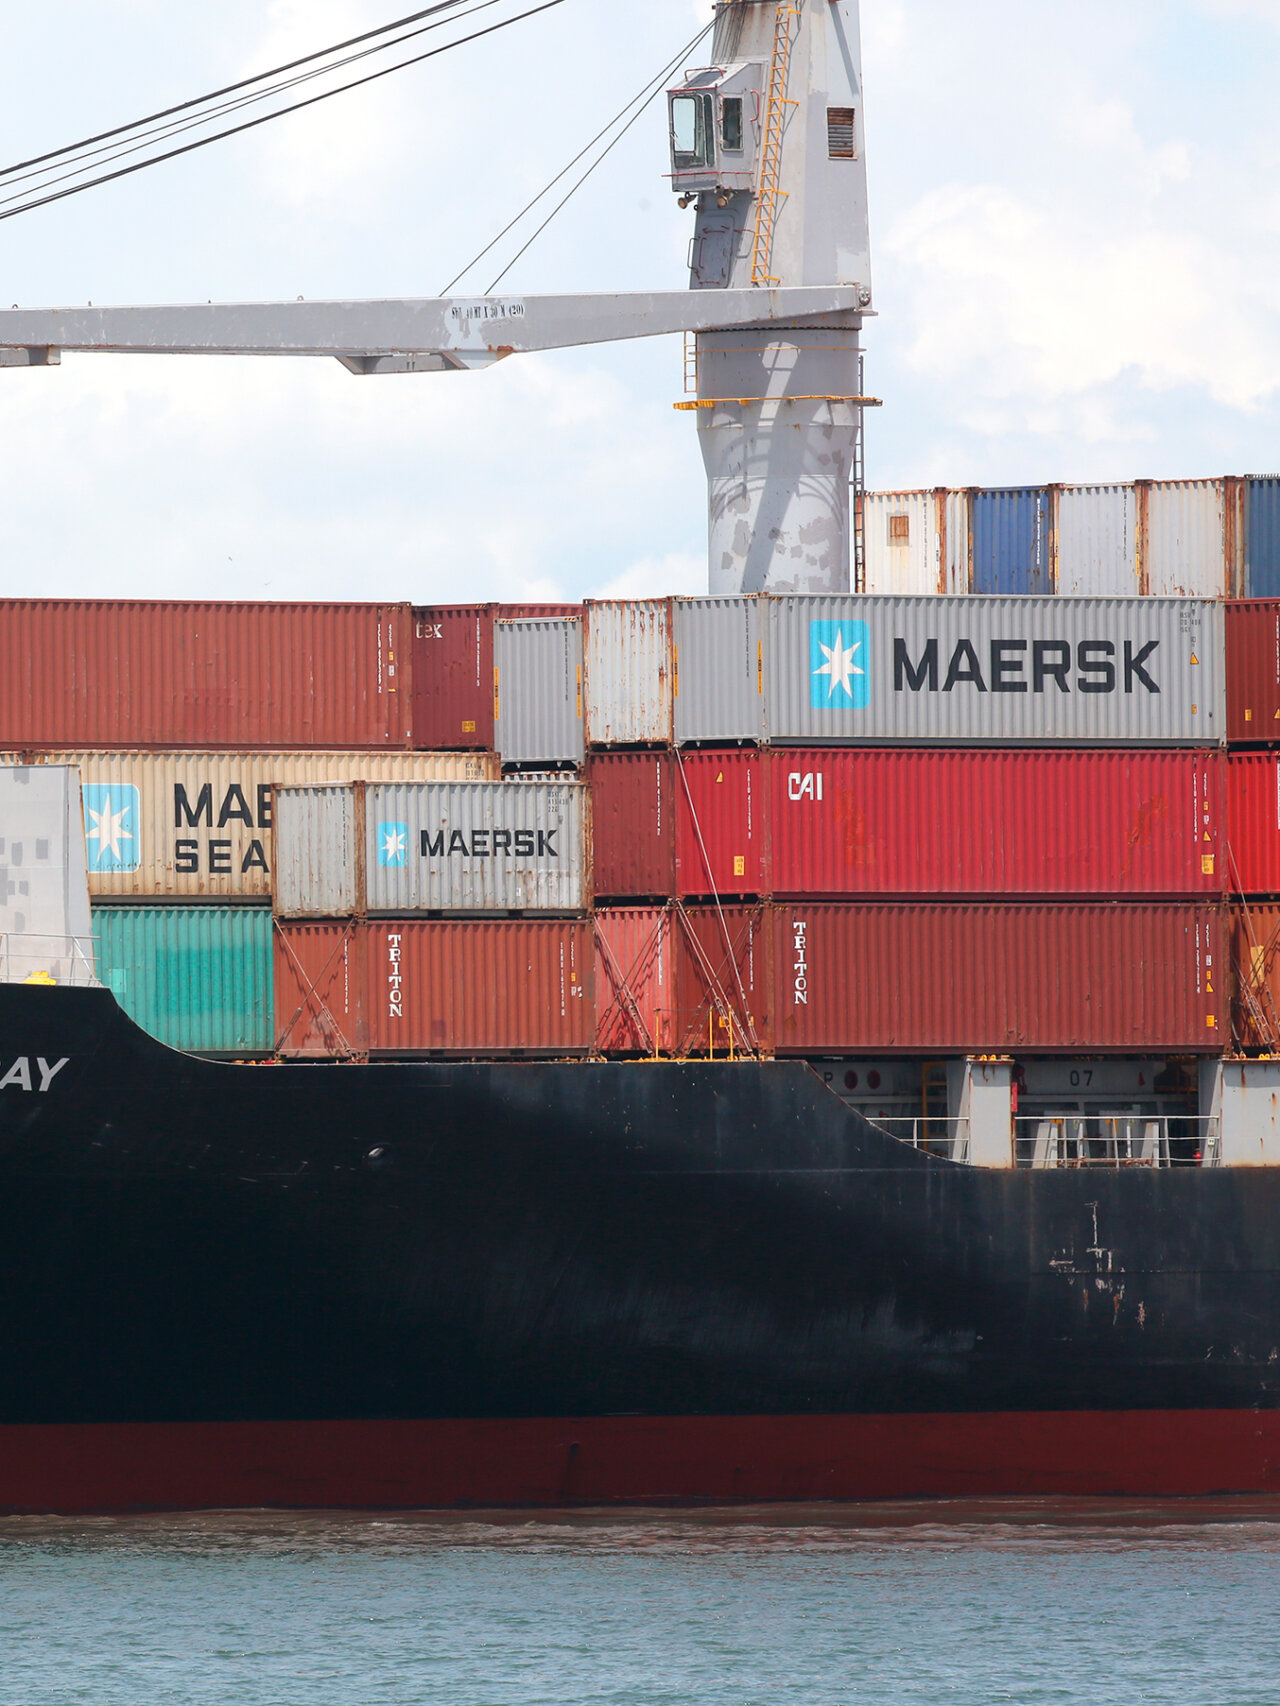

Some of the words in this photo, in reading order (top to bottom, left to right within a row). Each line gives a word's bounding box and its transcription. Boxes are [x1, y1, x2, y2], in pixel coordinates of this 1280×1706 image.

[416, 621, 443, 638] tex
[893, 638, 1161, 693] MAERSK
[788, 772, 822, 800] CAI
[175, 840, 269, 873] SEA
[420, 830, 558, 857] MAERSK
[388, 935, 402, 1016] TRITON
[793, 922, 807, 1004] TRITON
[1070, 1070, 1093, 1087] 07
